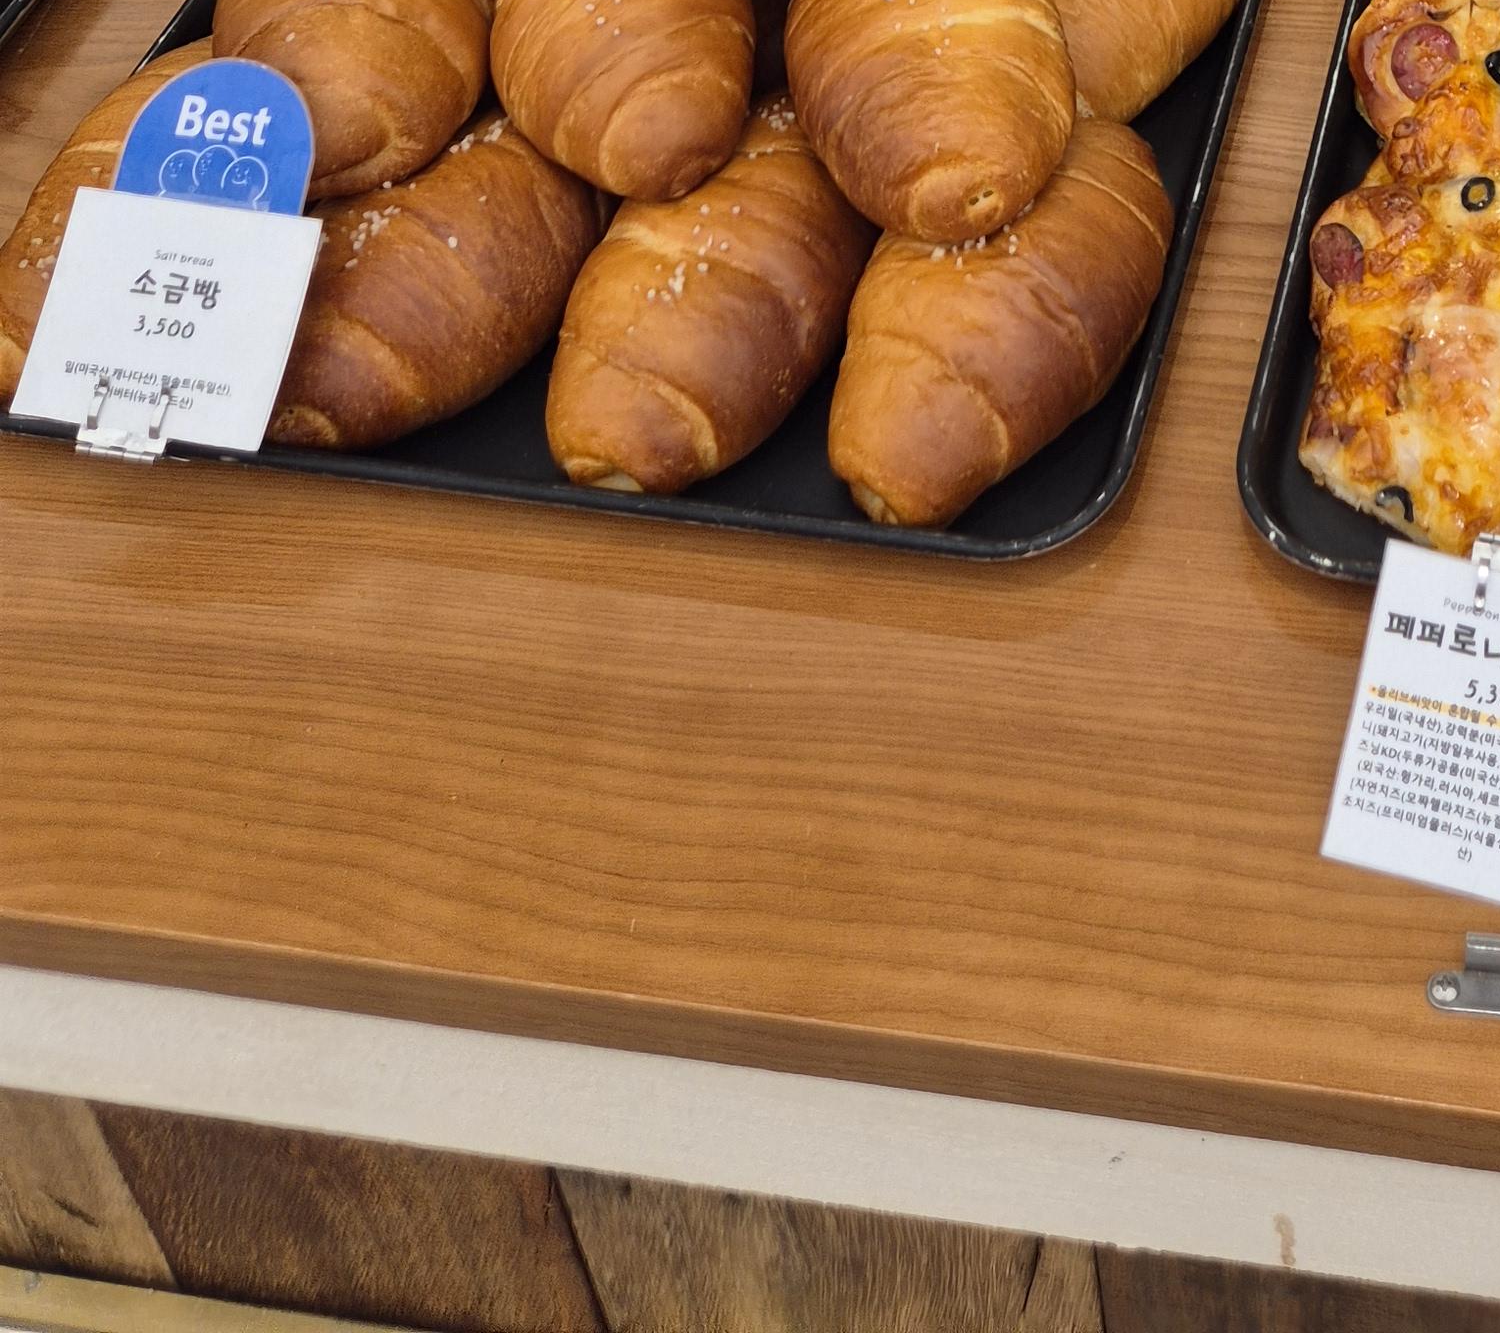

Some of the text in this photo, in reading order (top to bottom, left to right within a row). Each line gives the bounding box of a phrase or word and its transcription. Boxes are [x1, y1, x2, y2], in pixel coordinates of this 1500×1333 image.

[174, 93, 273, 147] Best
[179, 255, 214, 267] bread
[130, 268, 222, 310] 소금빵
[133, 314, 195, 339] 3,500
[1485, 712, 1498, 728] 수
[1456, 845, 1473, 862] 산)
